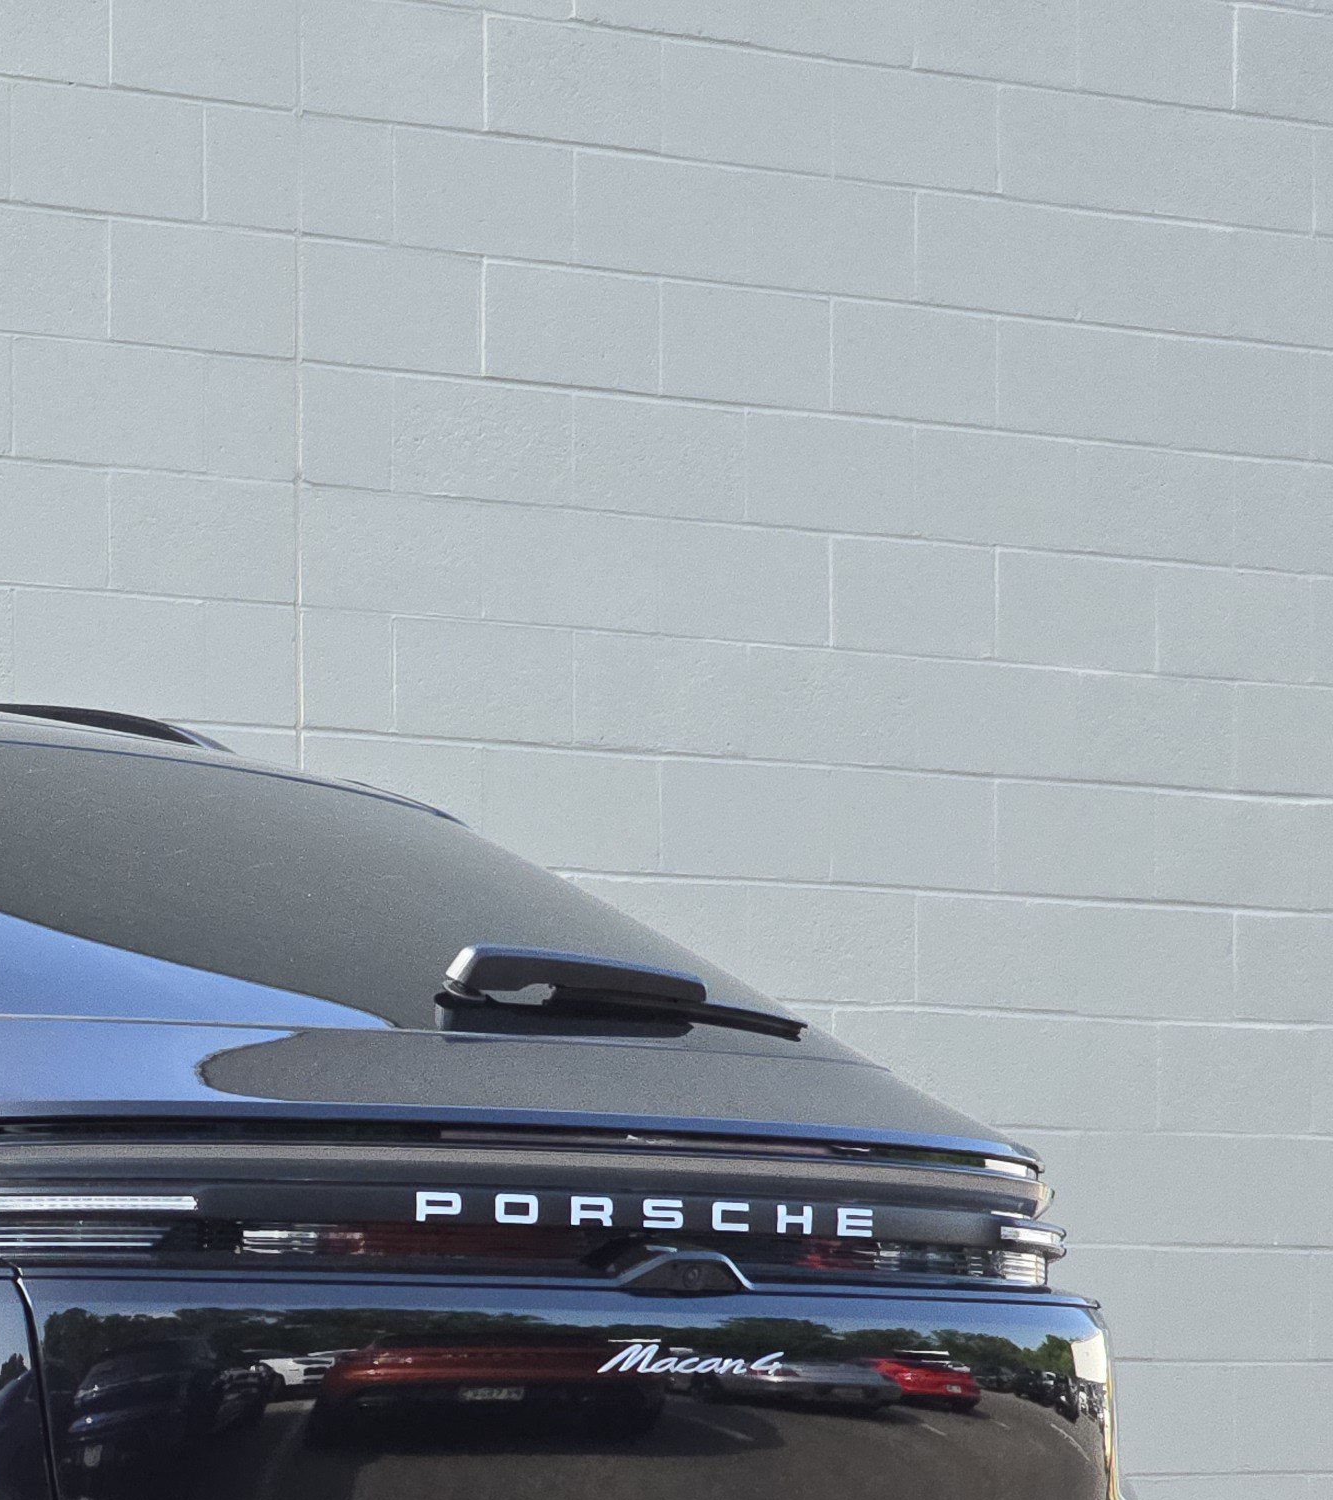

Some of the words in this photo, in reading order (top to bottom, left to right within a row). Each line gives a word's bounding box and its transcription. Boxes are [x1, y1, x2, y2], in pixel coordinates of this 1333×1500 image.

[416, 1190, 874, 1238] PORSCHE
[596, 1343, 747, 1375] Macan
[750, 1351, 785, 1376] 4
